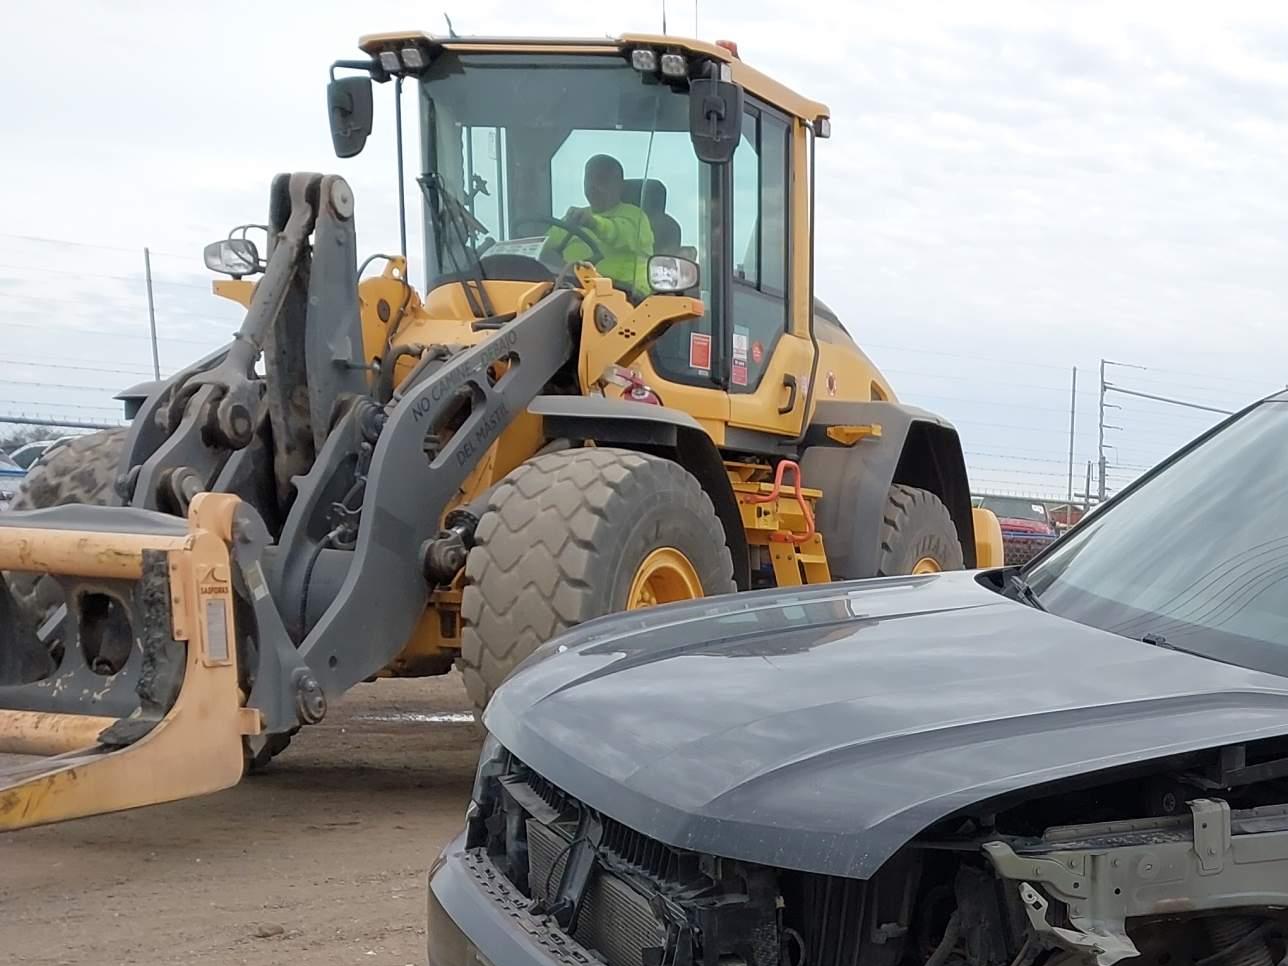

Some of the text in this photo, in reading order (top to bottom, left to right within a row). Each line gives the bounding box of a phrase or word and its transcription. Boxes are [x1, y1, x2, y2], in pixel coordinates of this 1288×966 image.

[411, 397, 431, 422] NO
[431, 363, 474, 400] CAMINE
[456, 440, 477, 467] DEL
